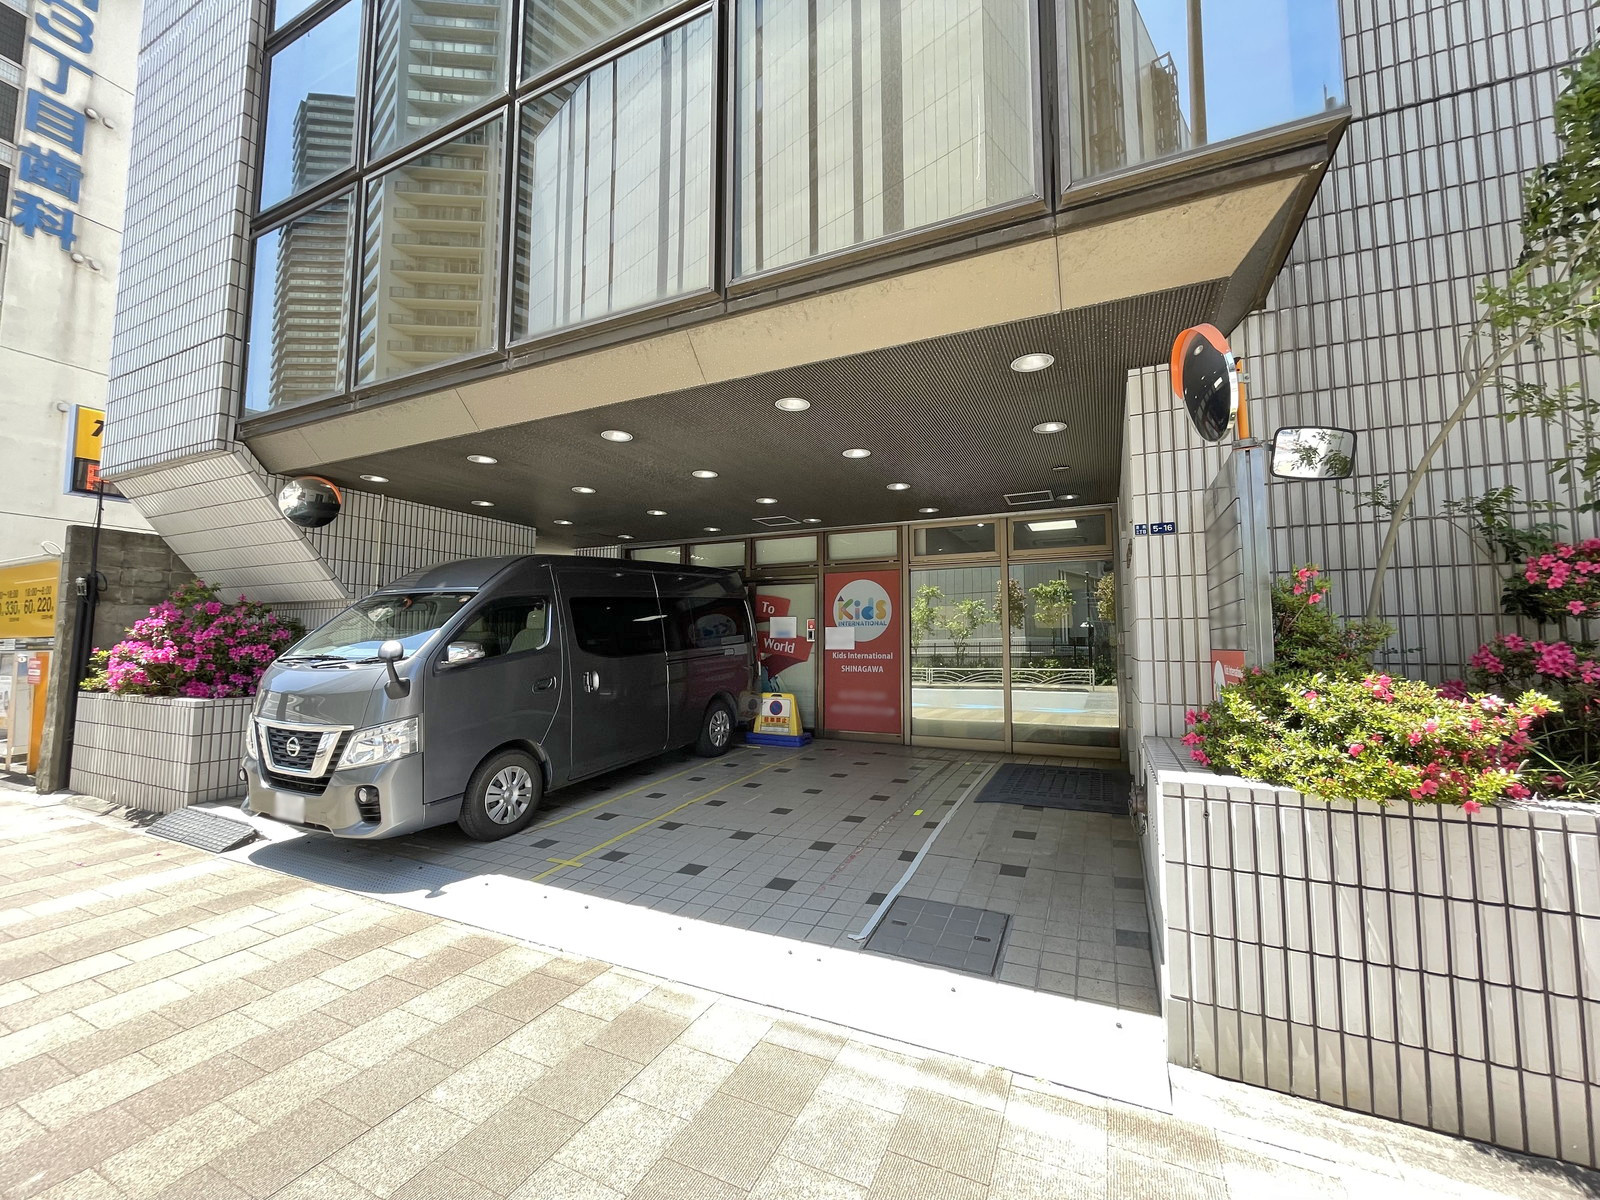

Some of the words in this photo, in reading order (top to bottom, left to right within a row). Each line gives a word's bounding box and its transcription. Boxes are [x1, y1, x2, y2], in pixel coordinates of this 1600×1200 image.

[12, 0, 98, 252] 3丁目歯科
[1152, 524, 1173, 532] 5-16
[762, 601, 775, 614] To
[838, 596, 887, 620] Kids
[763, 638, 795, 654] World
[848, 652, 893, 660] International
[841, 665, 884, 673] SHINAGAWA
